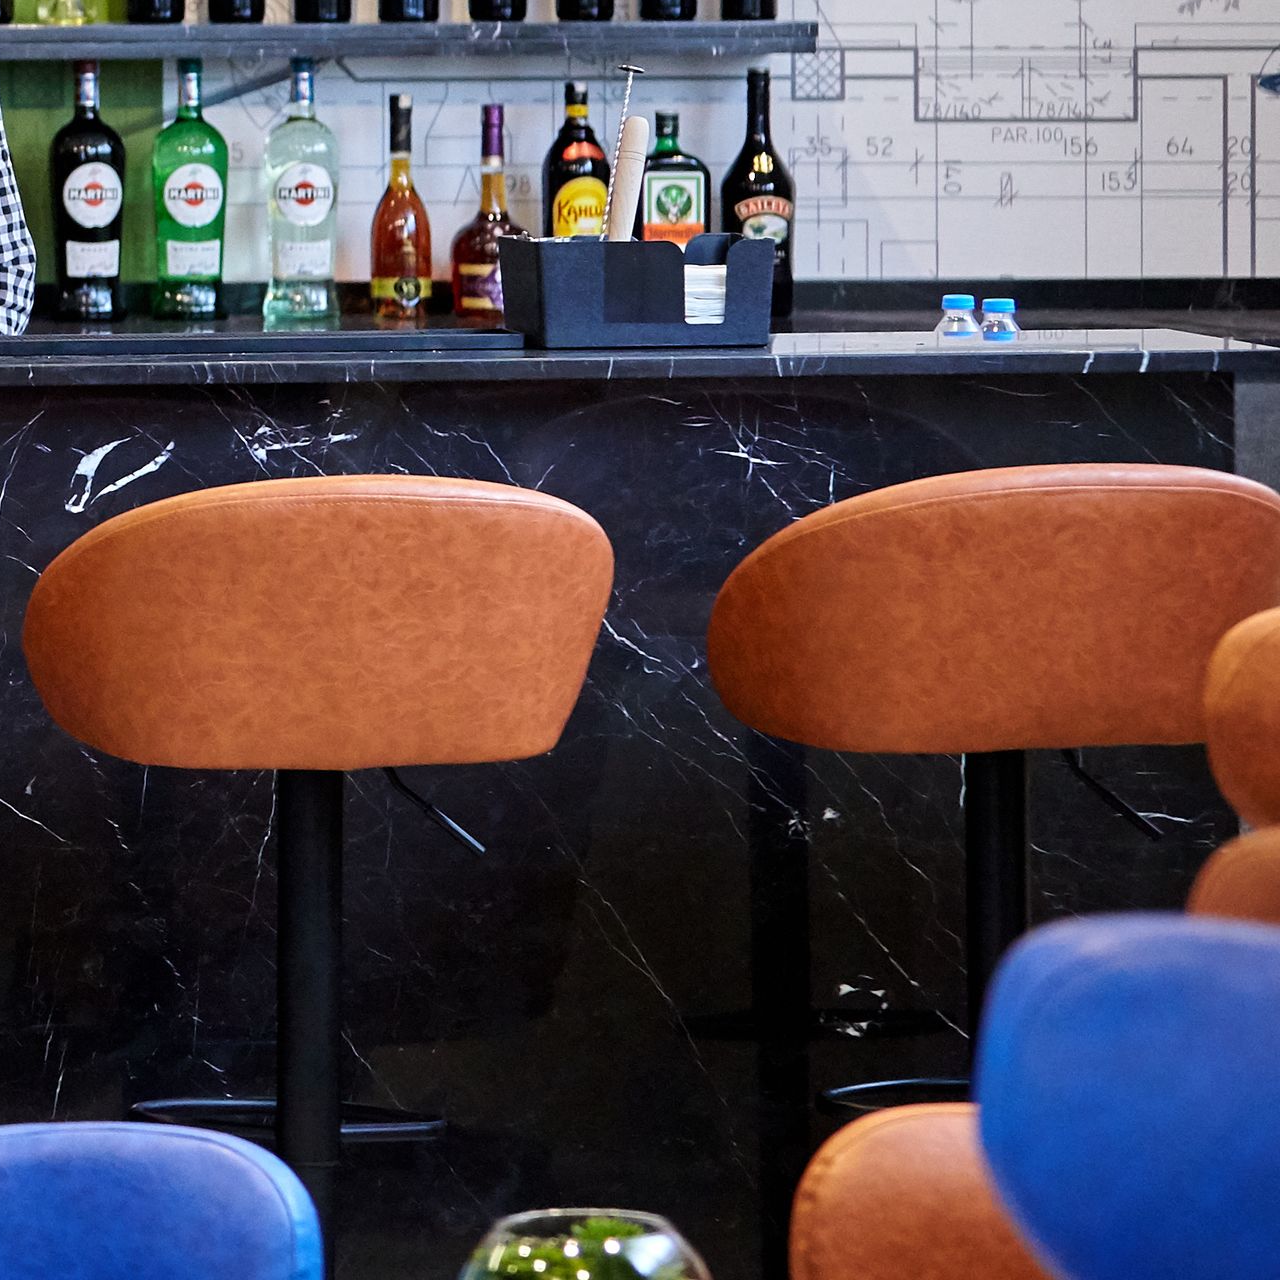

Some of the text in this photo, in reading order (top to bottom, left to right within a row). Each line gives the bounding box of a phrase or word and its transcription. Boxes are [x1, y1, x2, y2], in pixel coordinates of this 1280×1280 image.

[866, 136, 894, 157] 52
[1063, 136, 1099, 157] 156
[1166, 136, 1194, 156] 64
[1101, 171, 1136, 192] 153
[68, 187, 118, 200] MARTINI
[168, 187, 219, 200] MARTINI
[278, 187, 330, 200] MARTINI
